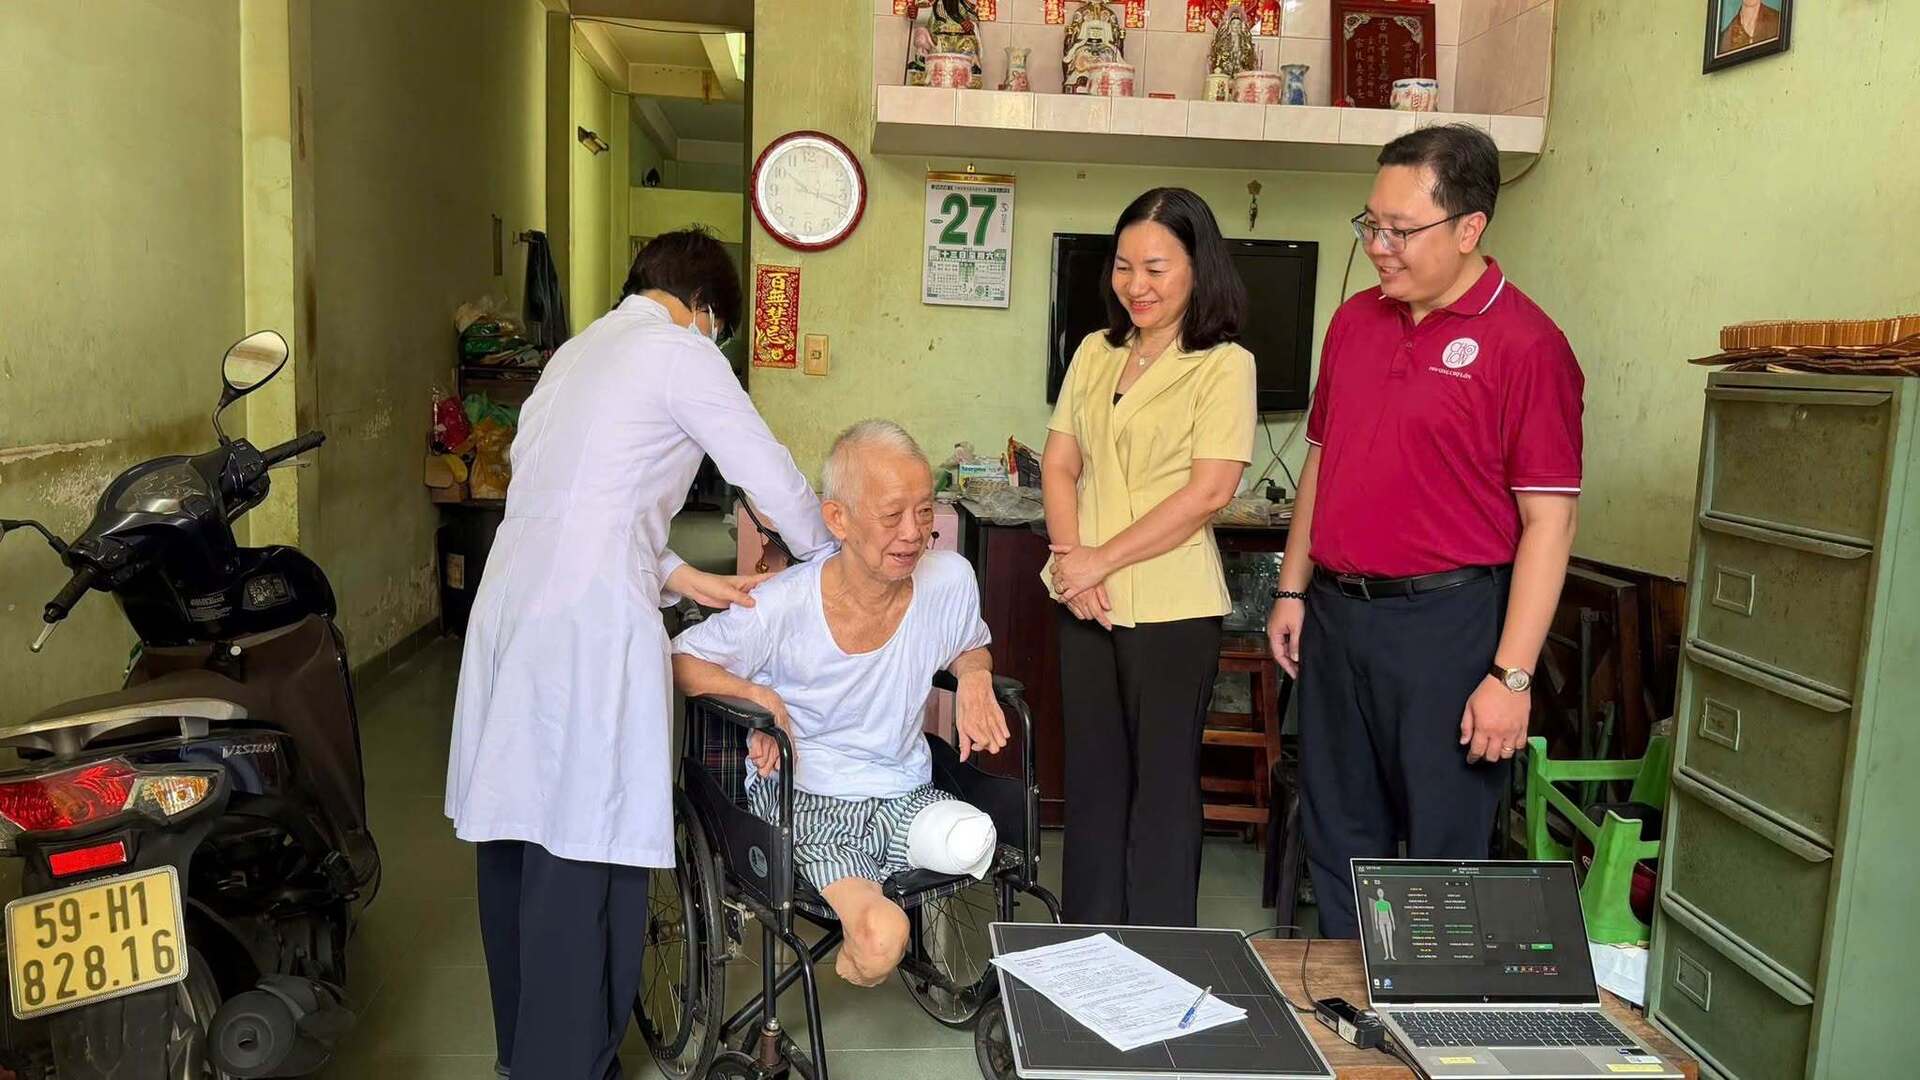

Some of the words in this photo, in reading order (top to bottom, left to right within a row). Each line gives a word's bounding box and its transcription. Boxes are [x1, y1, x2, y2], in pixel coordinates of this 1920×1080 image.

[788, 154, 797, 167] 11
[803, 150, 816, 163] 12
[825, 156, 829, 169] 1
[775, 166, 786, 178] 10
[835, 170, 844, 182] 2
[769, 183, 779, 197] 9
[839, 188, 848, 201] 3
[775, 202, 784, 215] 8
[788, 216, 796, 227] 7
[938, 192, 998, 247] 27
[804, 220, 812, 233] 6
[33, 880, 149, 950] 59-H1
[22, 928, 176, 1007] 828.16
